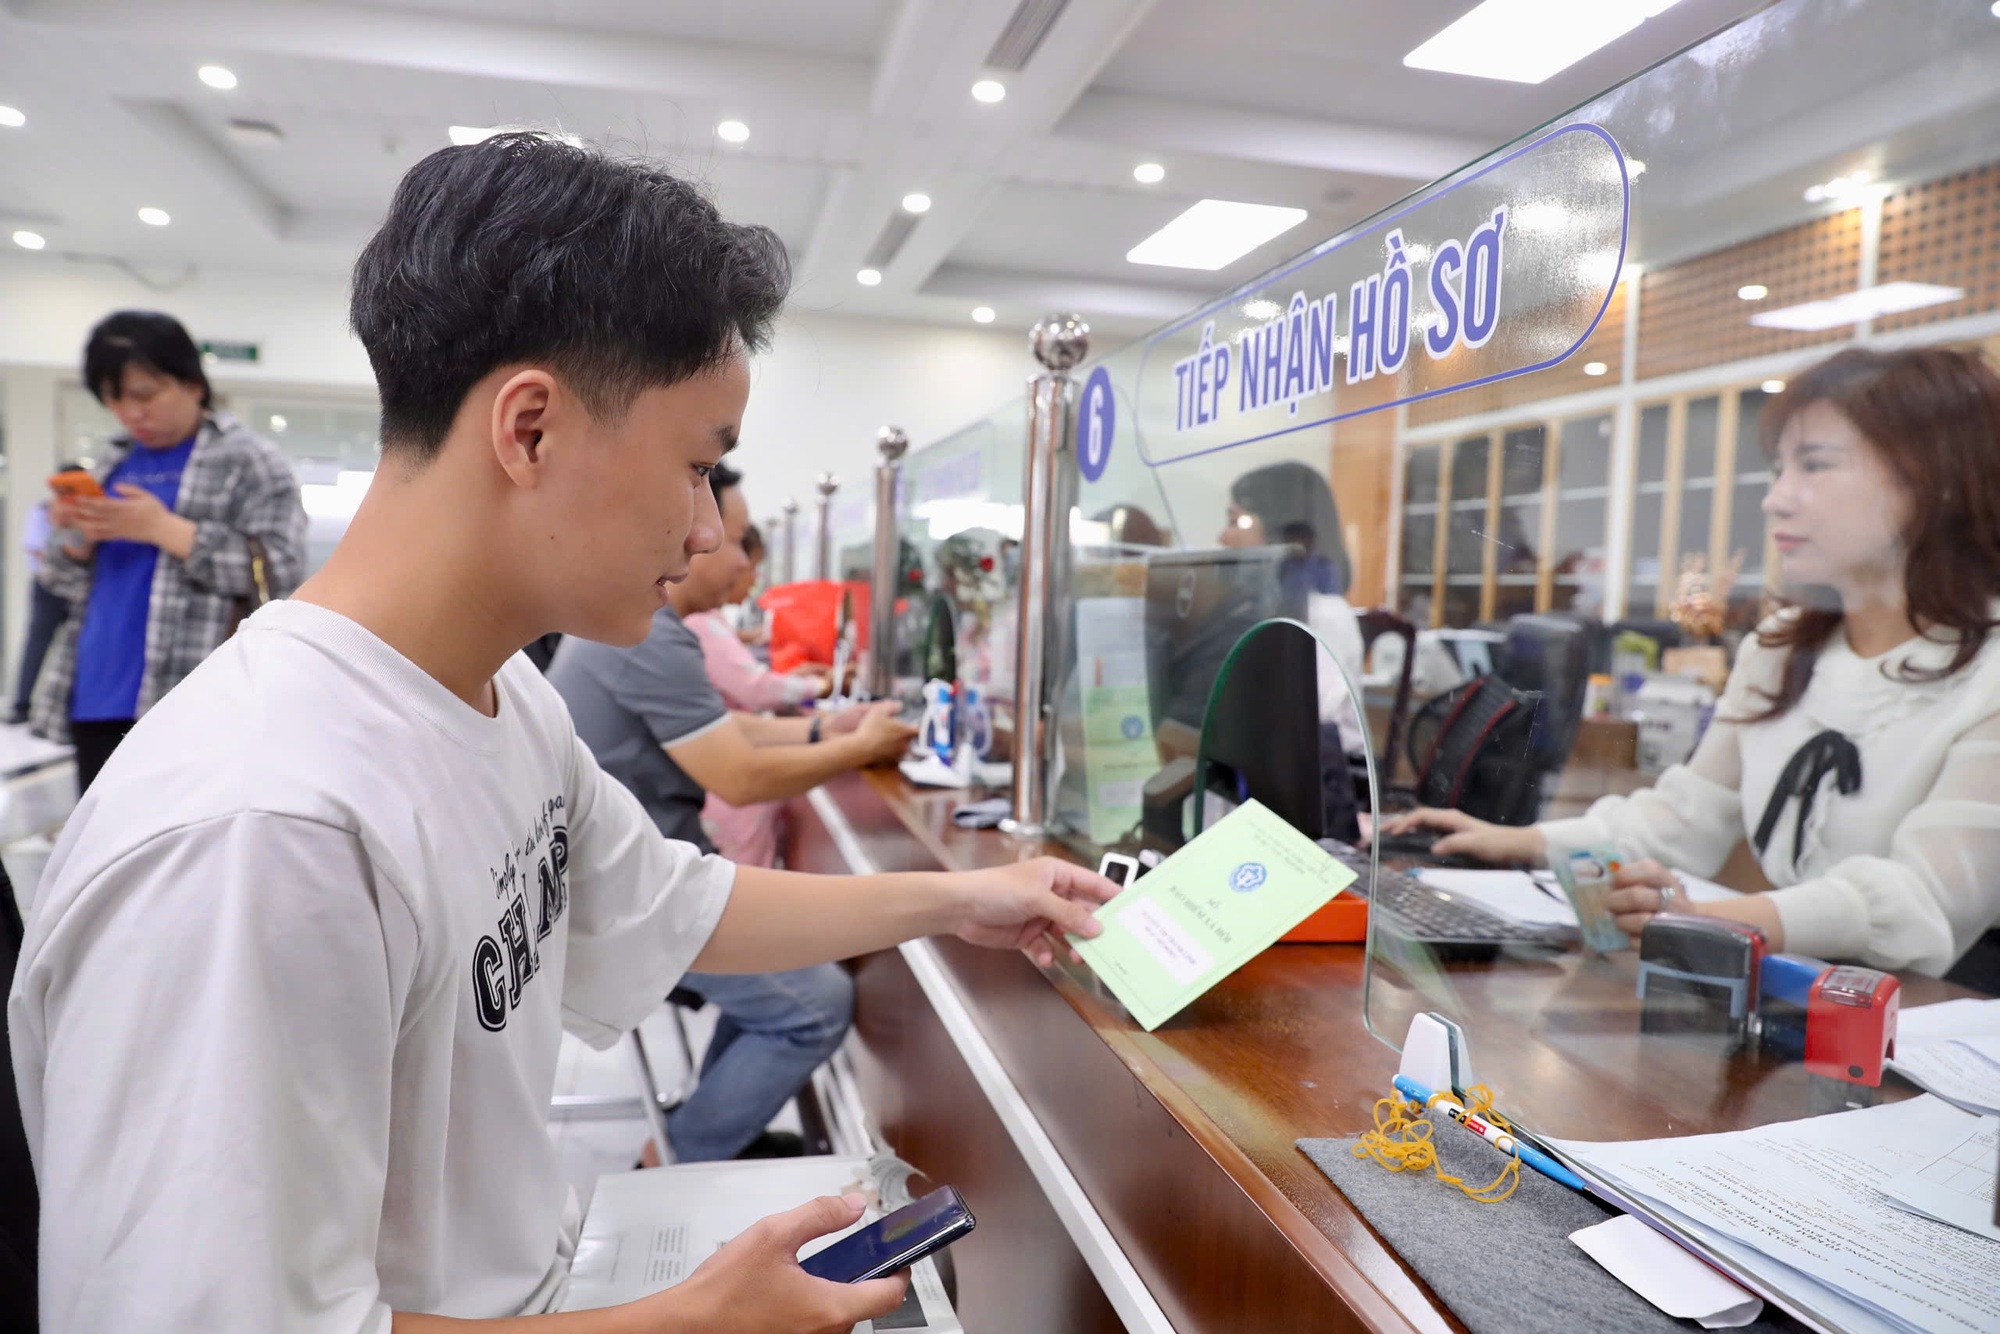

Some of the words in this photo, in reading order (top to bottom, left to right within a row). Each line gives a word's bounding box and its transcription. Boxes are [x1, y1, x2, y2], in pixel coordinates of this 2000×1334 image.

[1174, 320, 1231, 432] TIẾP
[1238, 290, 1336, 416] NHẬN
[1347, 229, 1413, 384] HỒ
[1425, 204, 1508, 360] SƠ
